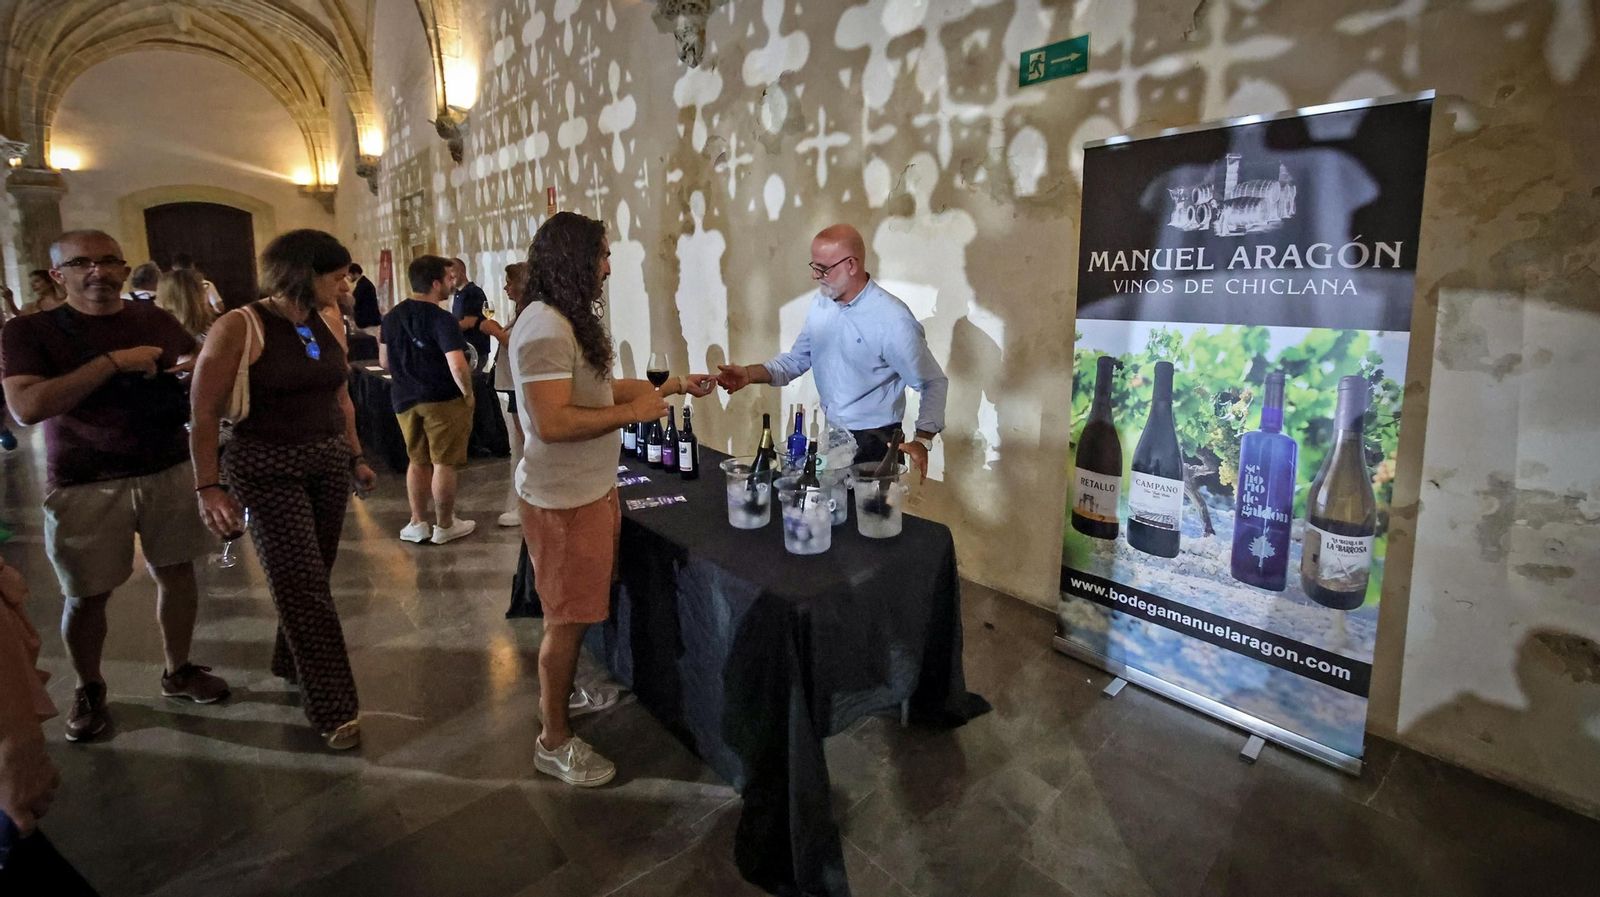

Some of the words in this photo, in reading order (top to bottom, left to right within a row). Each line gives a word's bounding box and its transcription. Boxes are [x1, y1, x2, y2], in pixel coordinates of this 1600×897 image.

[1087, 247, 1215, 272] MANUEL
[1226, 234, 1404, 270] ARAGÓN
[1113, 279, 1174, 293] VINOS
[1184, 278, 1214, 294] DE
[1225, 278, 1359, 296] CHICLANA
[1080, 477, 1115, 493] RETALLO
[1135, 478, 1179, 494] CAMPANO
[1326, 542, 1334, 550] LA
[1335, 544, 1367, 553] BARROSA
[1070, 575, 1352, 682] www.bodegamanuelaragon.com
